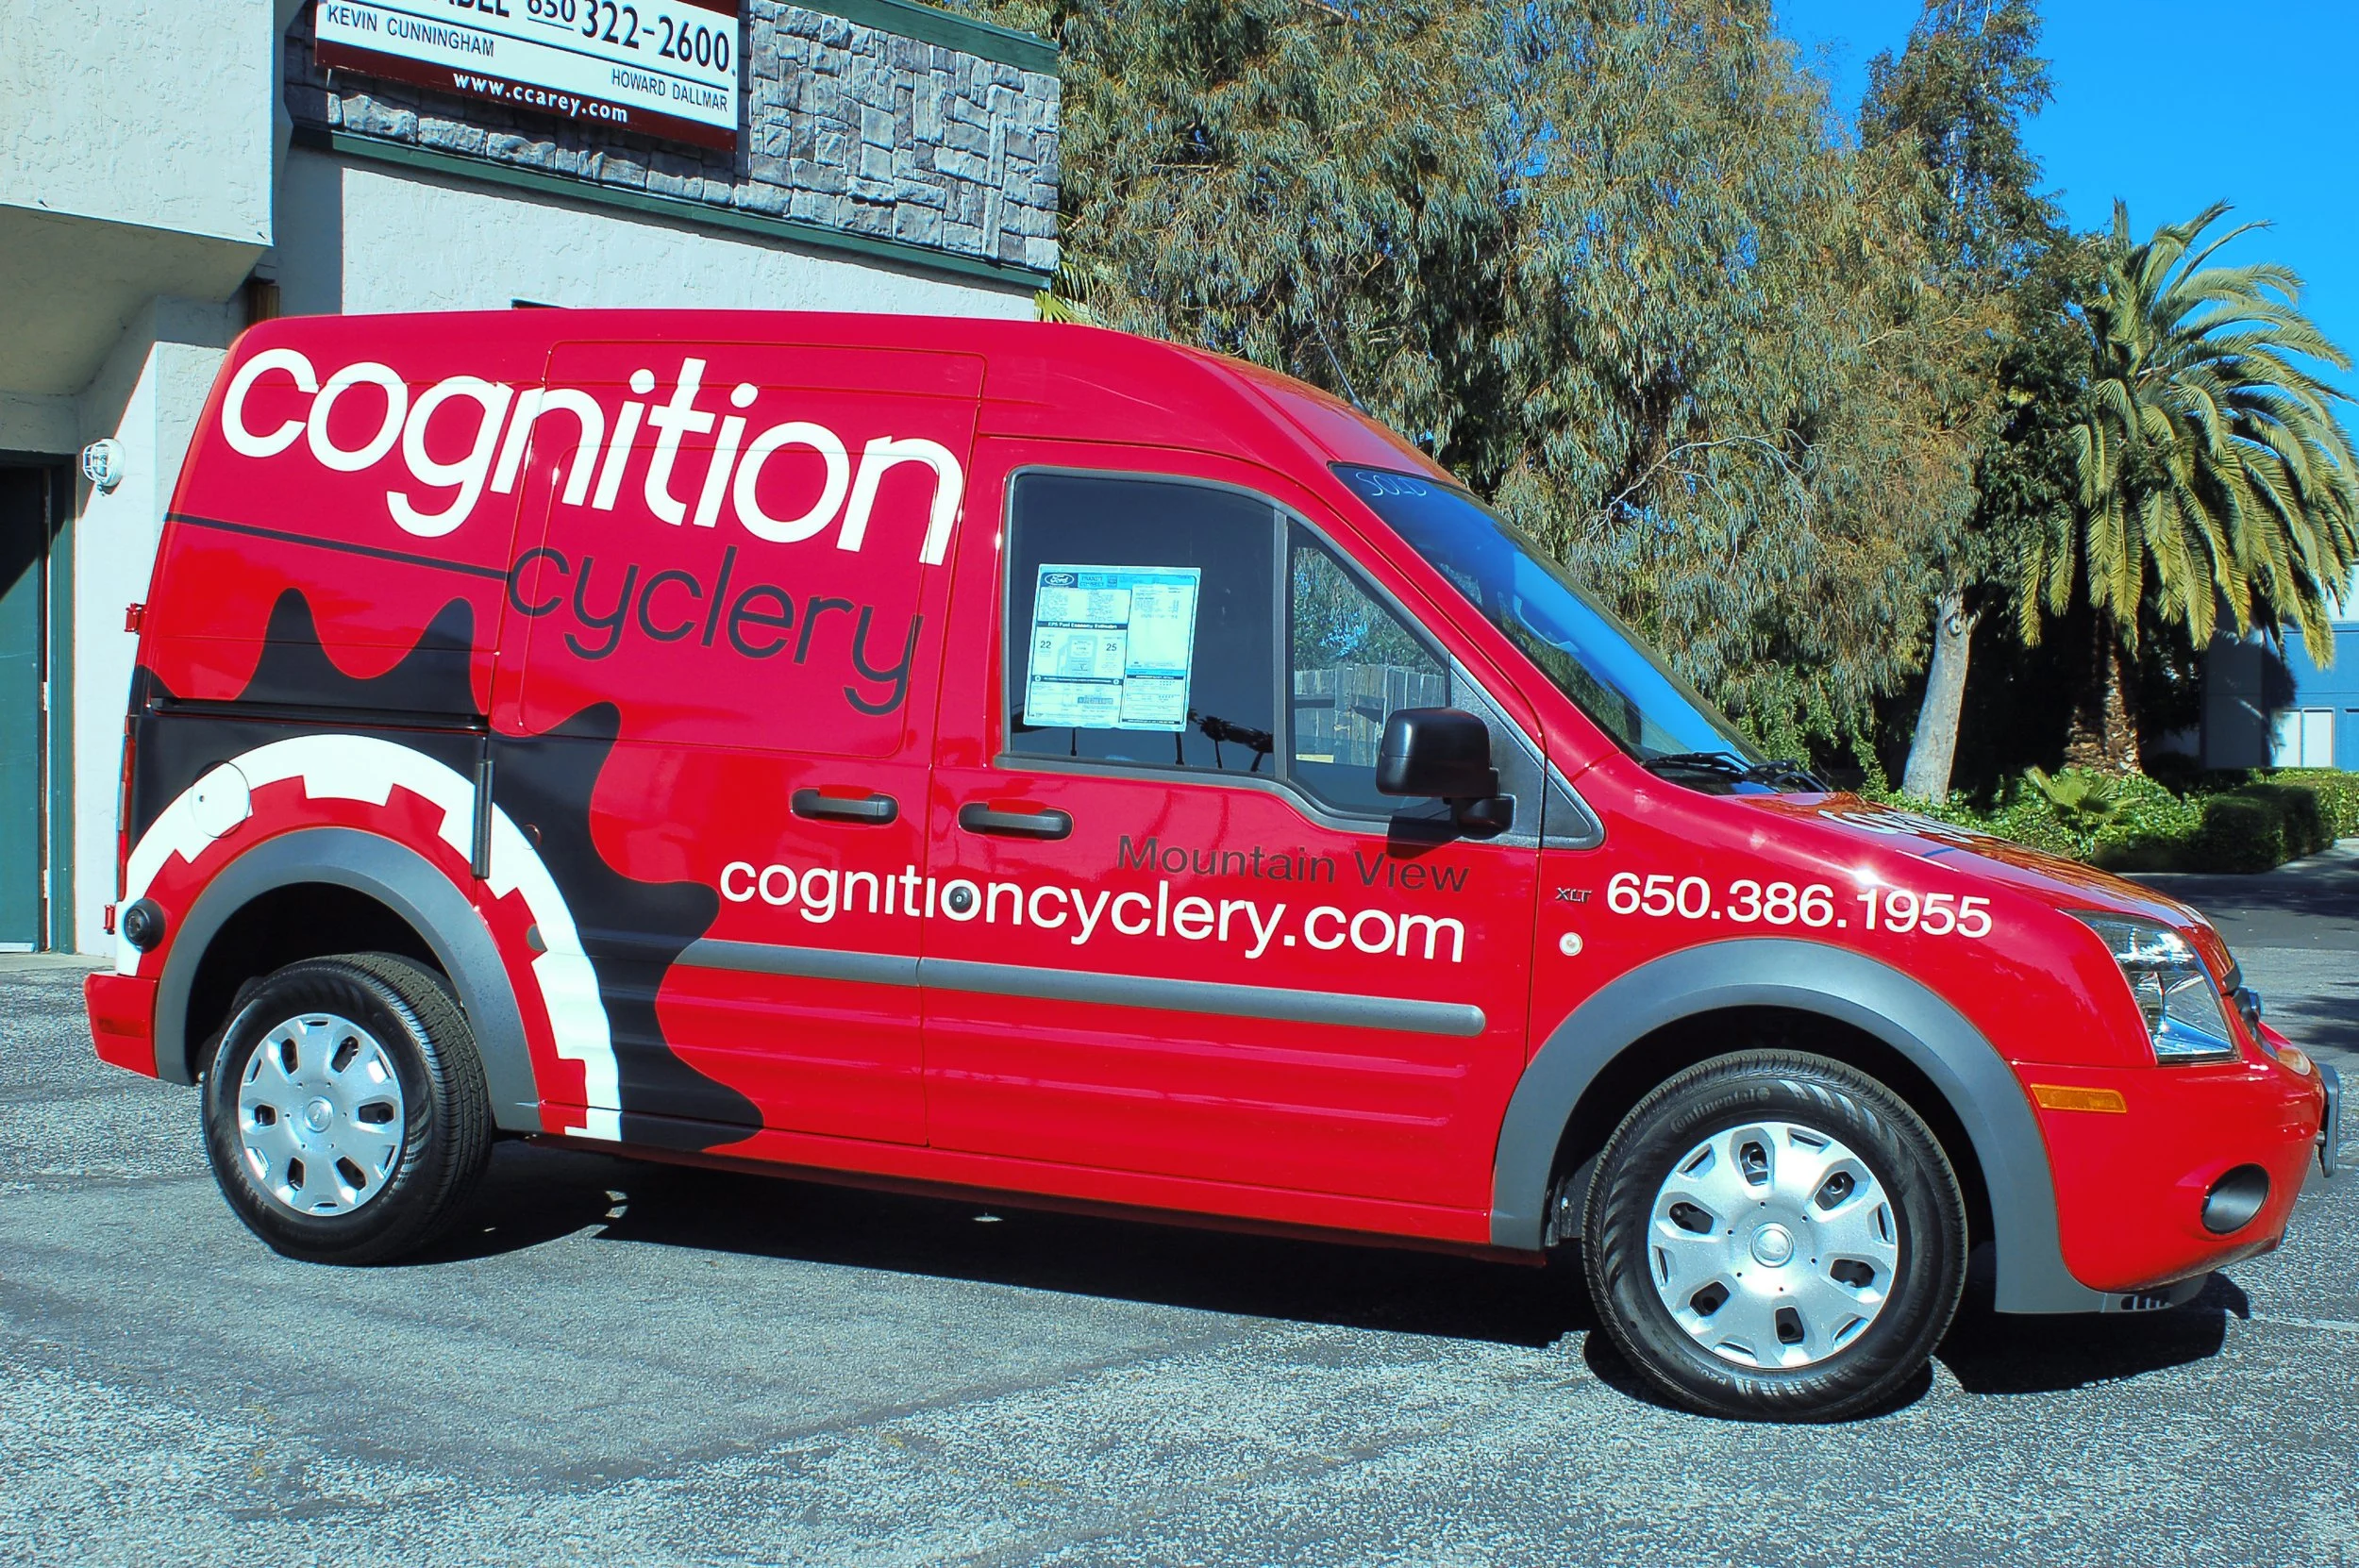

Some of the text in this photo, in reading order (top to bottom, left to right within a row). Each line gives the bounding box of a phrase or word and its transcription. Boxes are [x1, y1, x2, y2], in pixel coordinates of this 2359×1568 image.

[327, 8, 495, 58] KEVIN CUNNINGHAM
[453, 73, 629, 123] www.ccarey.com
[611, 68, 728, 112] HOWARD DALLMAR
[221, 348, 964, 566] cognition
[508, 545, 924, 716] cyclery
[1040, 641, 1052, 650] 22
[1106, 642, 1117, 652] 25
[1117, 834, 1471, 892] Mountain View
[720, 861, 1465, 963] cognitioncyclery.com
[1555, 886, 1593, 904] XLT
[1606, 871, 1994, 939] 650.386.1955
